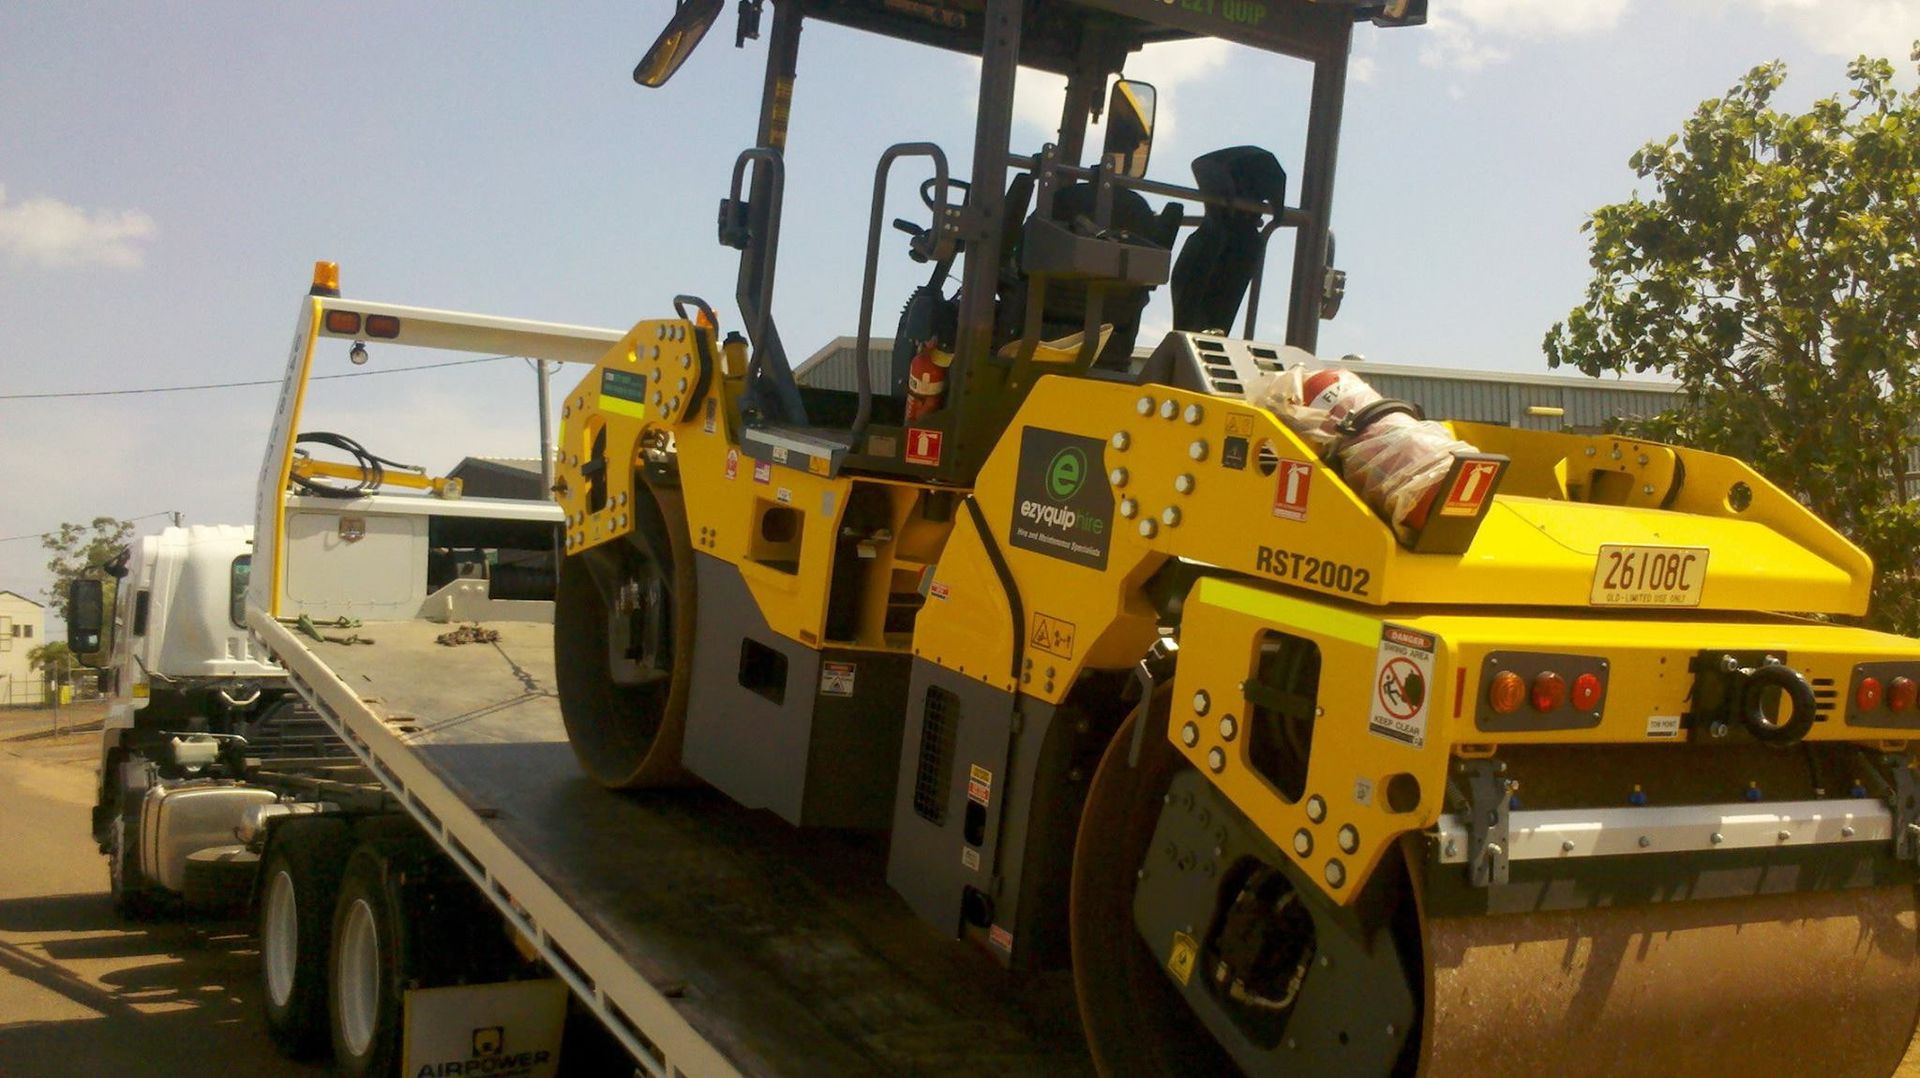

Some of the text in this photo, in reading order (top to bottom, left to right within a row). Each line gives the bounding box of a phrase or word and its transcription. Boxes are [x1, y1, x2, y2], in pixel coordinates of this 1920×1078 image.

[1256, 545, 1371, 597] RST2002
[1603, 551, 1697, 591] 26108C
[1391, 631, 1425, 647] DANGER
[1410, 649, 1429, 661] AREA
[1374, 715, 1393, 727] KEEP
[1395, 721, 1420, 735] CLEAR
[417, 1050, 551, 1078] AIRPOWER
